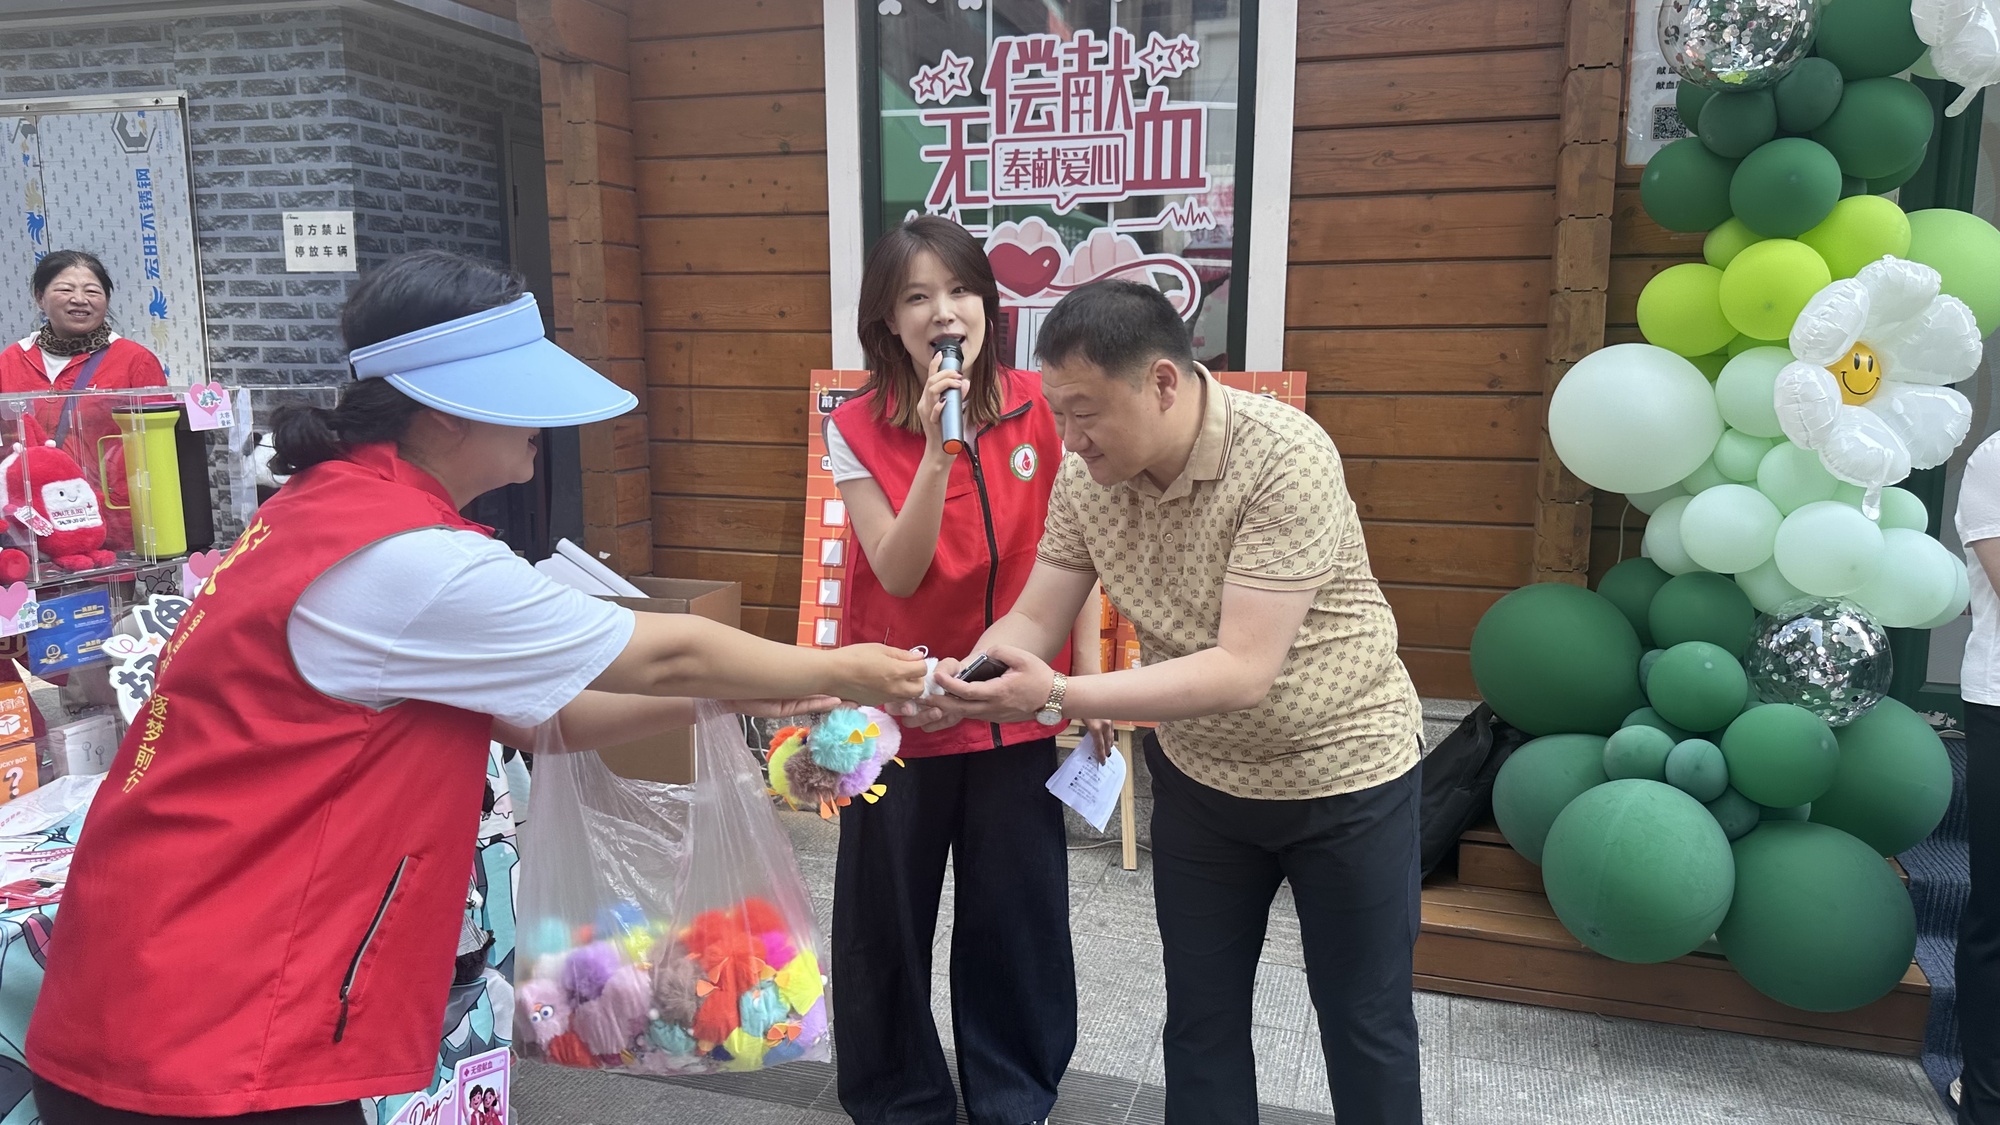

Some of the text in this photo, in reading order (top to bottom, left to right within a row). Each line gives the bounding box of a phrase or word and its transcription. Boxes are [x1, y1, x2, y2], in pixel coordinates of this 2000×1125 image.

[924, 31, 1206, 206] 无偿献血
[1003, 144, 1121, 189] 奉献爱心
[135, 168, 161, 280] 宏旺不锈钢
[293, 223, 347, 236] 前方禁止
[295, 245, 348, 258] 停放车辆
[15, 756, 28, 766] BOX
[122, 693, 169, 793] 逐梦前行
